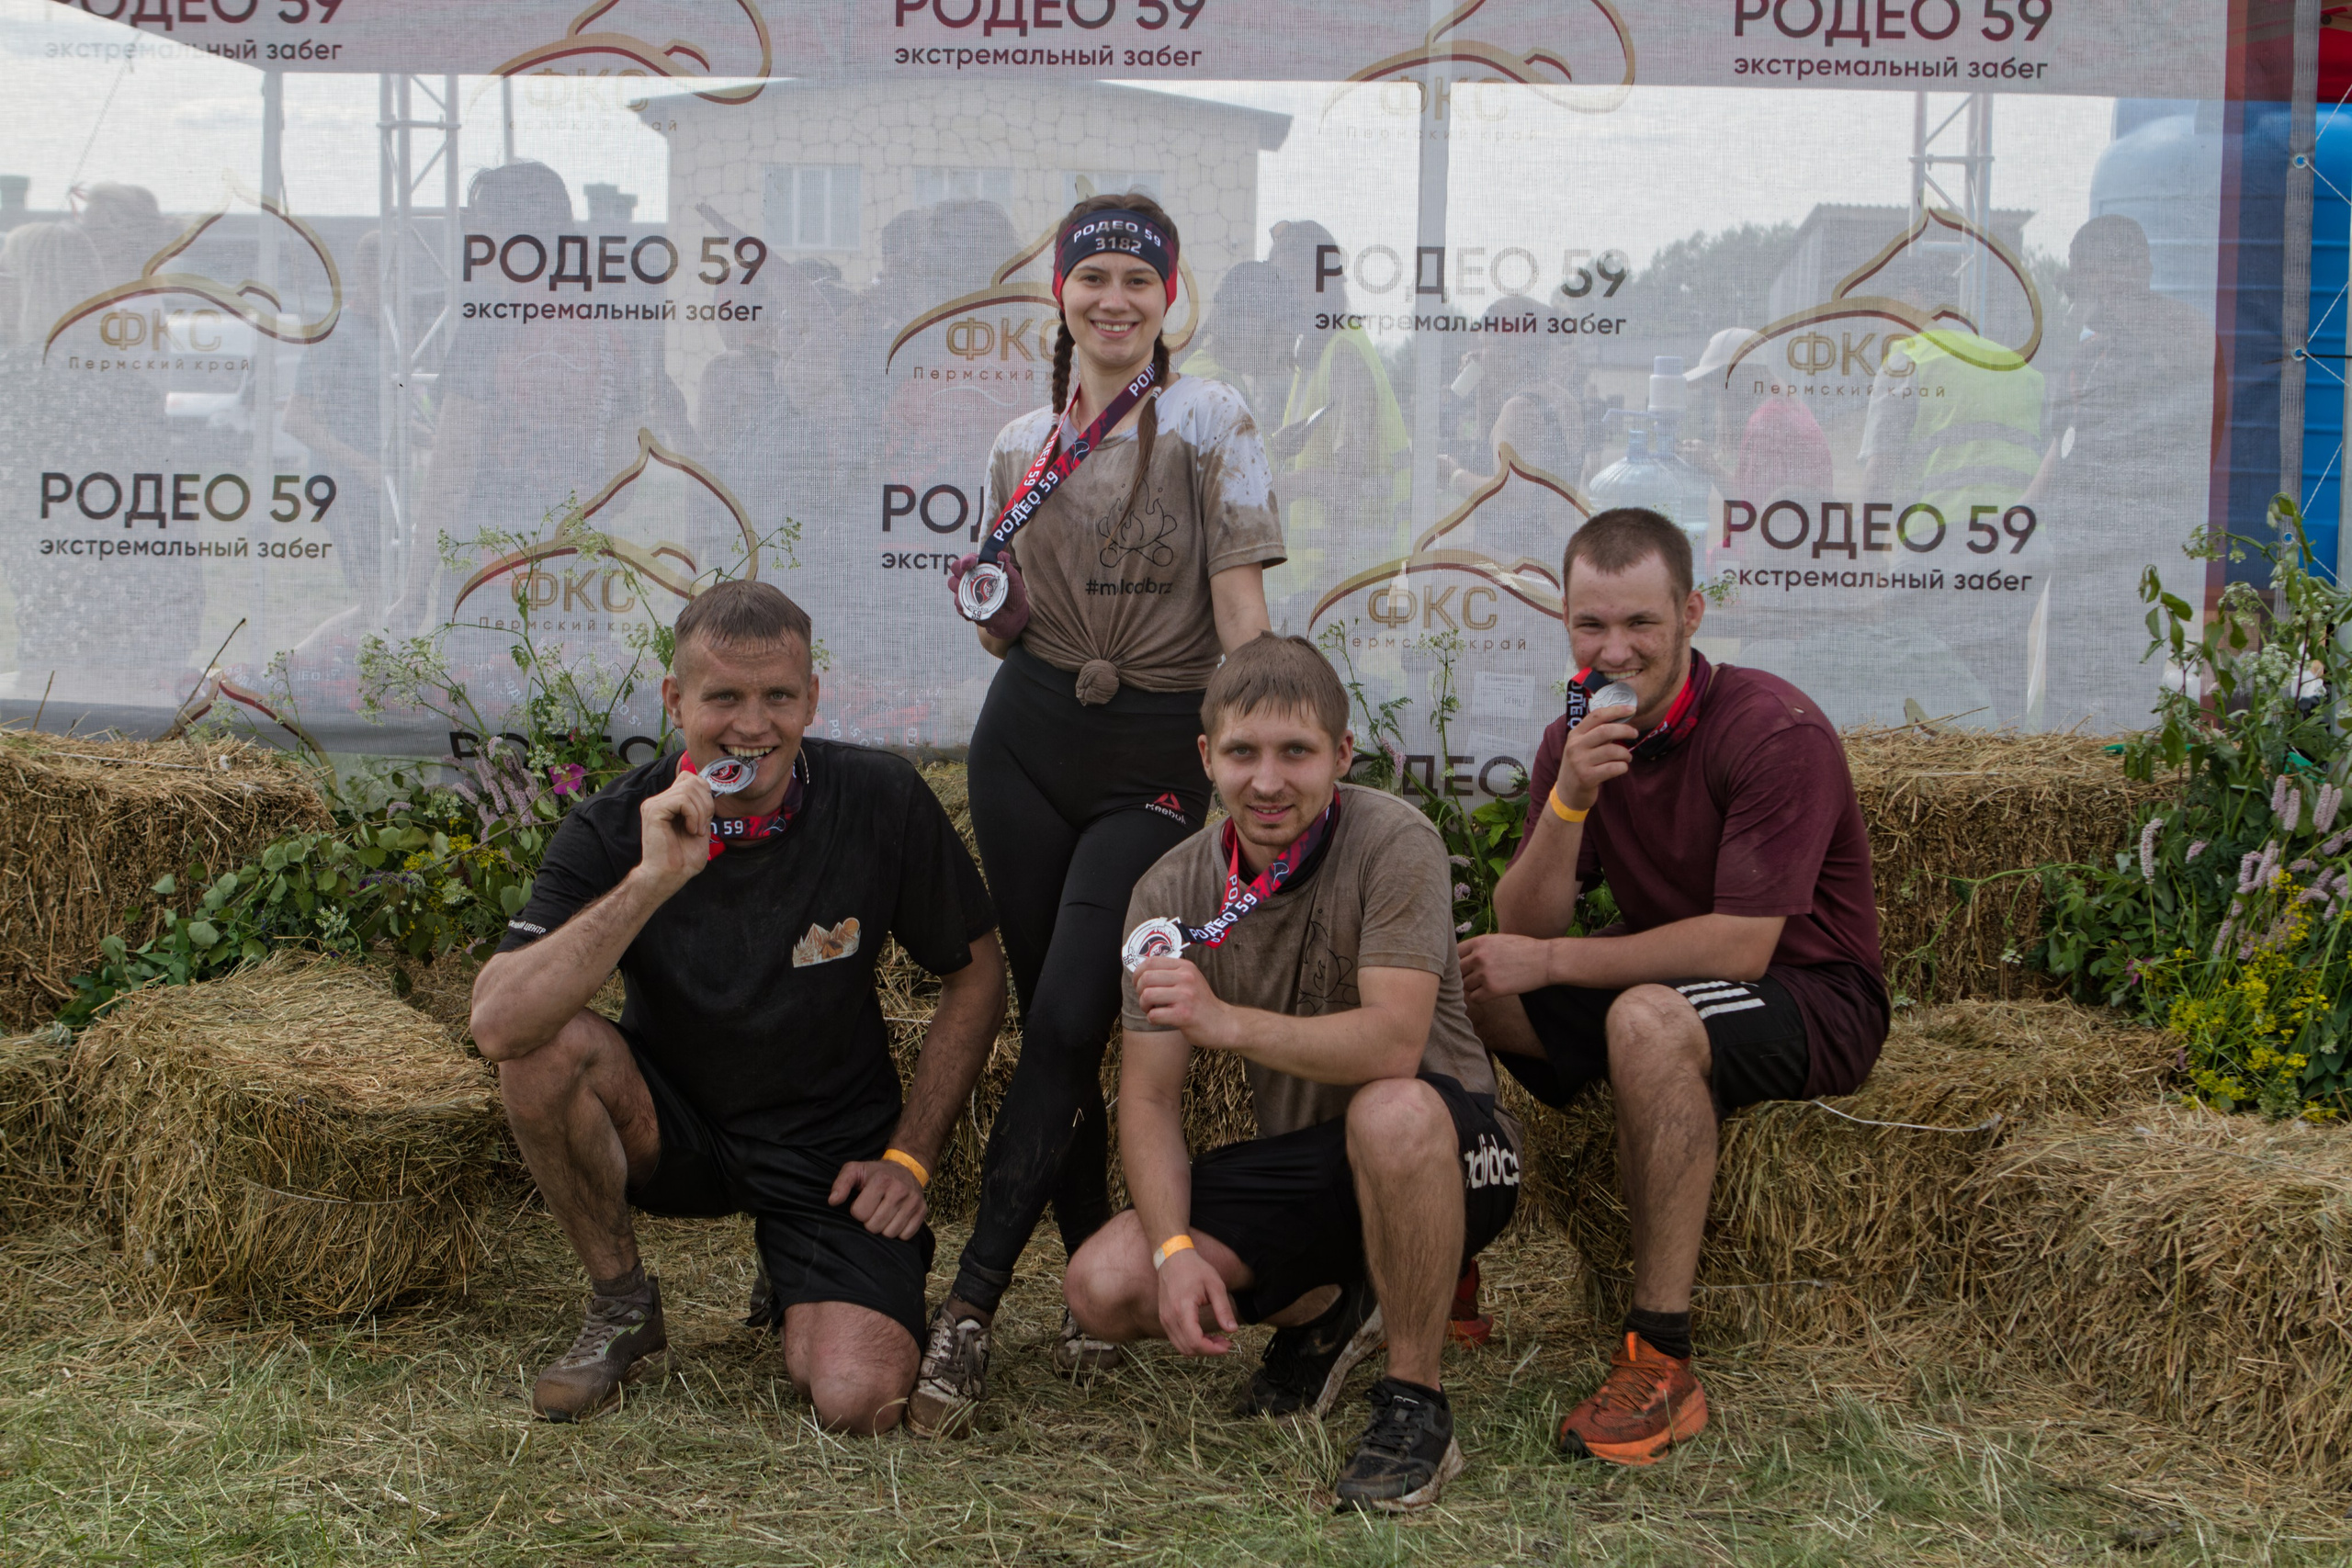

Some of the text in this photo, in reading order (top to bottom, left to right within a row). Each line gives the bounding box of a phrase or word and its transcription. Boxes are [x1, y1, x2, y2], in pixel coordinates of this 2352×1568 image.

[46, 0, 259, 31] ОДЕО
[895, 0, 1205, 37] РОДЕО 59
[1735, 0, 2052, 48] РОДЕО 59
[46, 39, 343, 63] экстремальный забег
[894, 45, 1202, 70] экстремальный забег
[1735, 57, 2048, 80] экстремальный забег
[1073, 220, 1161, 247] РОДЕО 59
[1095, 236, 1142, 254] 3182
[463, 234, 767, 291] РОДЕО 59
[1316, 244, 1630, 304] РОДЕО 59
[462, 299, 763, 323] экстремальный забег
[1315, 312, 1627, 335] экстремальный забег
[100, 309, 222, 352] ФКС
[69, 356, 250, 372] Пермский край
[1787, 332, 1917, 378] ФКС
[913, 367, 1035, 382] Пермский
[1753, 381, 1946, 400] Пермский край
[40, 471, 337, 528] РОДЕО 59
[993, 470, 1059, 541] РОДЕО 59
[1723, 500, 2037, 559] РОДЕО 59
[40, 537, 333, 561] экстремальный забег
[512, 569, 636, 614] ФКС
[1723, 569, 2032, 592] экстремальный забег
[1368, 584, 1498, 631] ФКС
[479, 616, 595, 632] Пермский
[1469, 637, 1527, 651] край
[724, 820, 744, 835] 59
[1189, 911, 1238, 941] РОДЕО
[1235, 892, 1258, 913] 59
